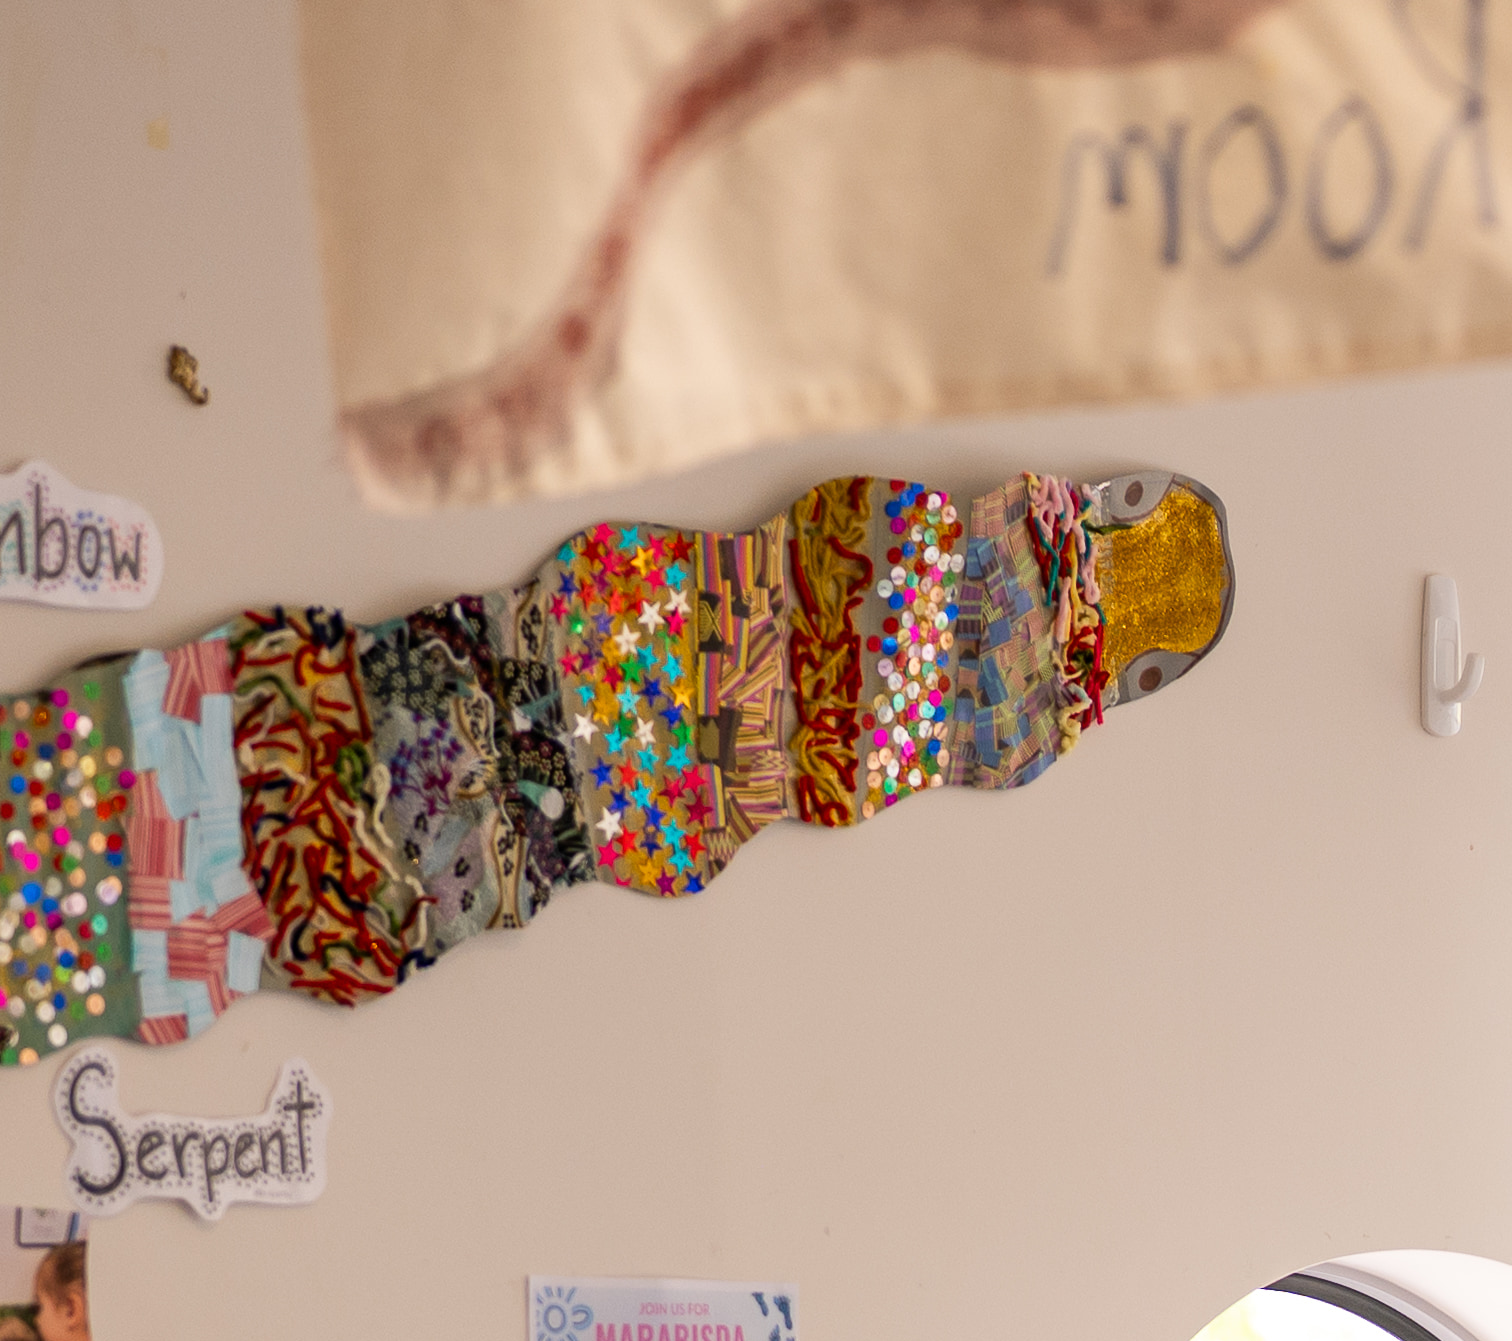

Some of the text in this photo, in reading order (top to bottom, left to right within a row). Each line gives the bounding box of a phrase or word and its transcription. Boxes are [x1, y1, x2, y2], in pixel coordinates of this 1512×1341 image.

[68, 1062, 316, 1202] Serpent
[639, 1302, 710, 1317] JOIN US FOR
